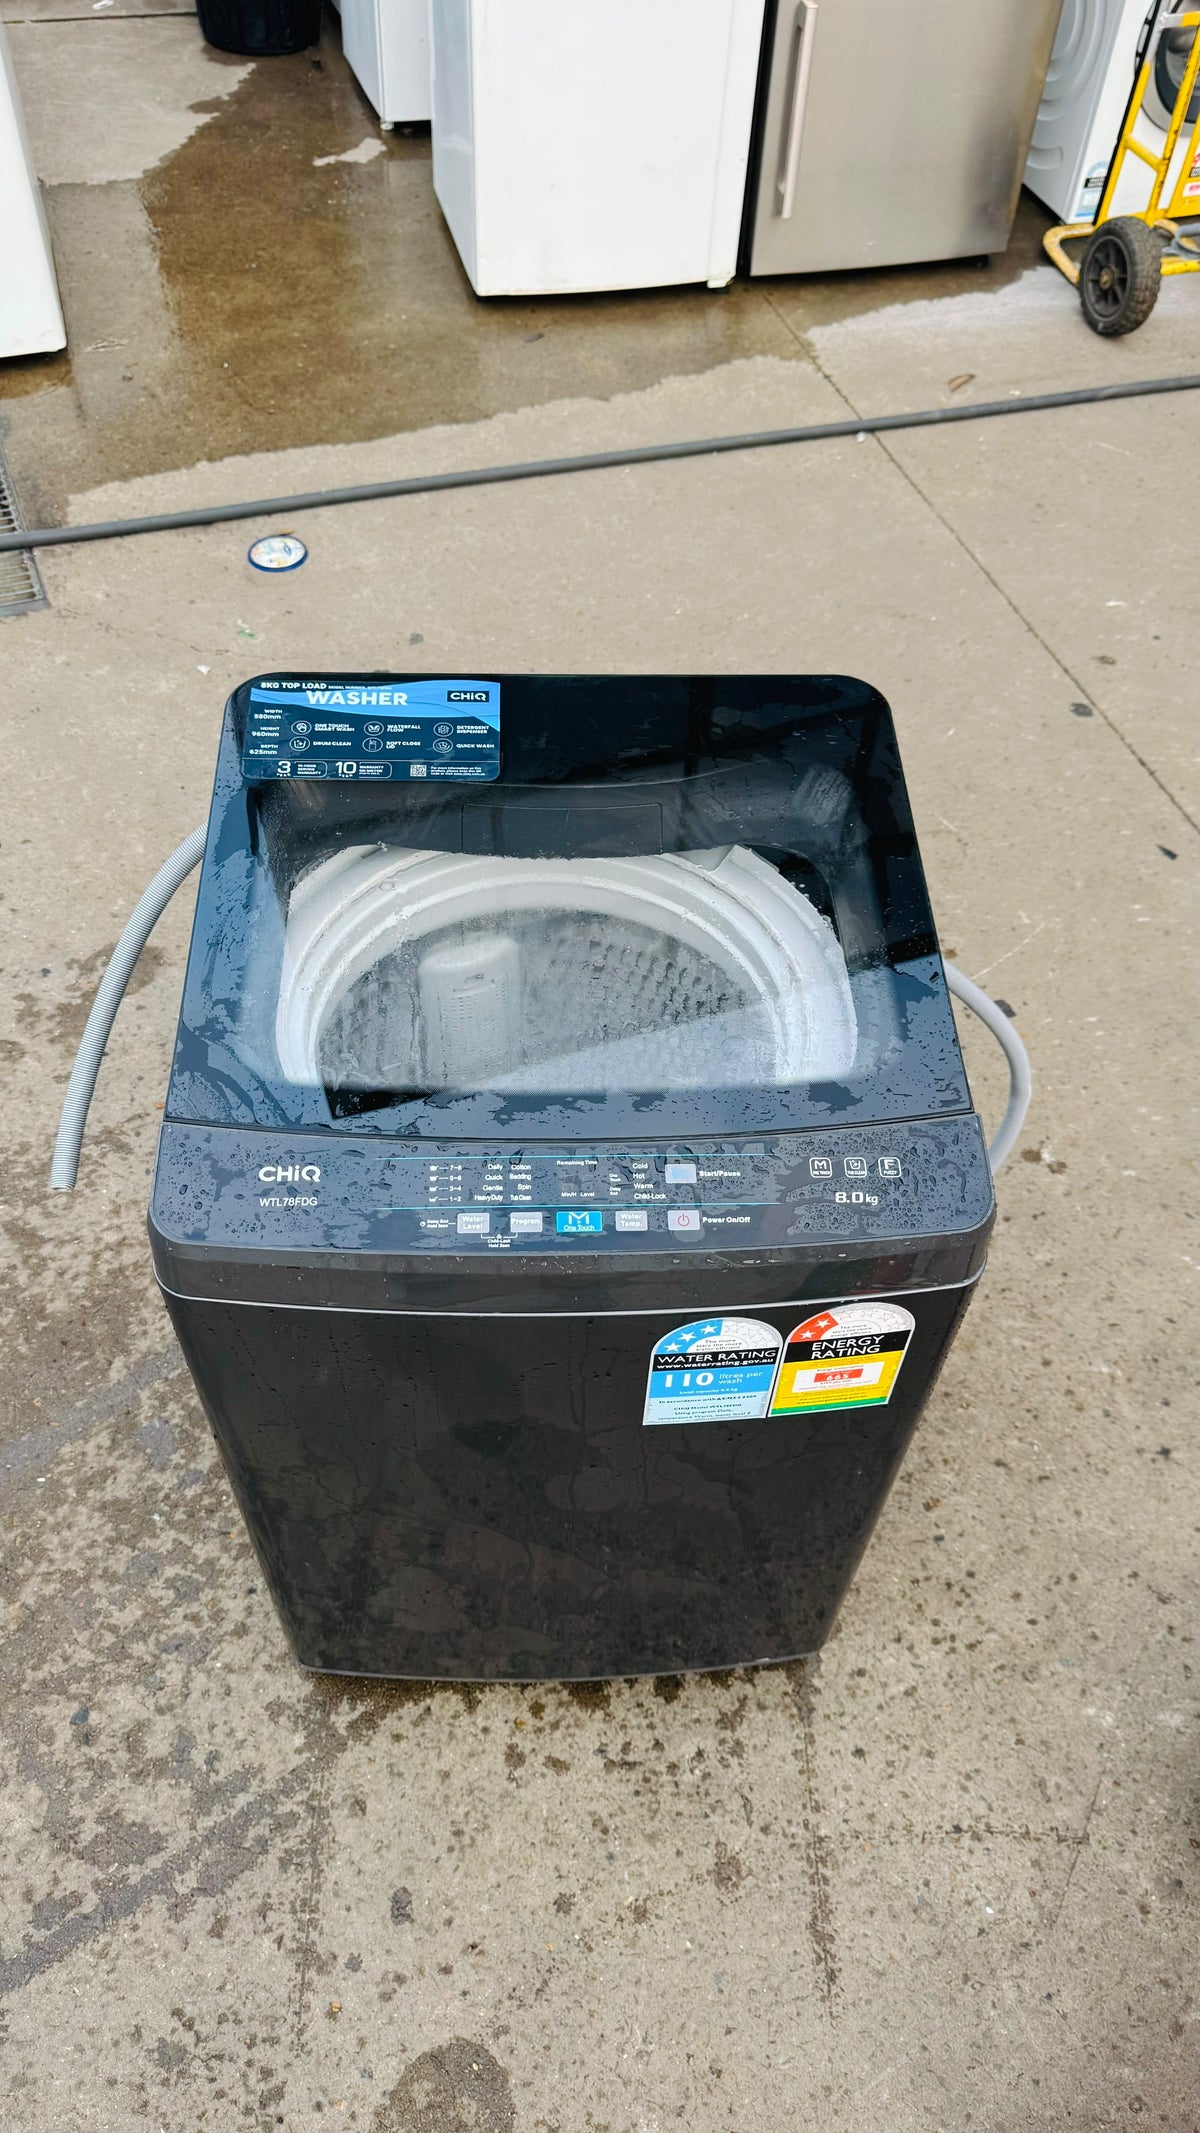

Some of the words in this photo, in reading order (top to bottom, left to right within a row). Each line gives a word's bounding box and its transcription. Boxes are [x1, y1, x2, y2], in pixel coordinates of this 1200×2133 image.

[302, 682, 327, 690] LOAD
[306, 691, 408, 706] WASHER
[277, 761, 291, 774] 3
[335, 761, 357, 774] 10
[884, 1159, 895, 1170] F
[258, 1165, 321, 1182] CHiQ
[517, 1183, 532, 1191] Spin
[259, 1197, 318, 1207] WTL78FDG
[634, 1192, 667, 1200] Child-Lock
[835, 1192, 864, 1203] 8.0
[865, 1193, 878, 1205] kg
[511, 1217, 541, 1226] Program
[620, 1220, 643, 1228] Temp.
[811, 1335, 885, 1351] ENERGY
[658, 1354, 712, 1363] WATER
[718, 1350, 776, 1360] RATING
[811, 1344, 880, 1360] RATING
[657, 1358, 774, 1369] www.waterrating.gov.au
[665, 1372, 714, 1388] 110
[746, 1371, 764, 1379] per
